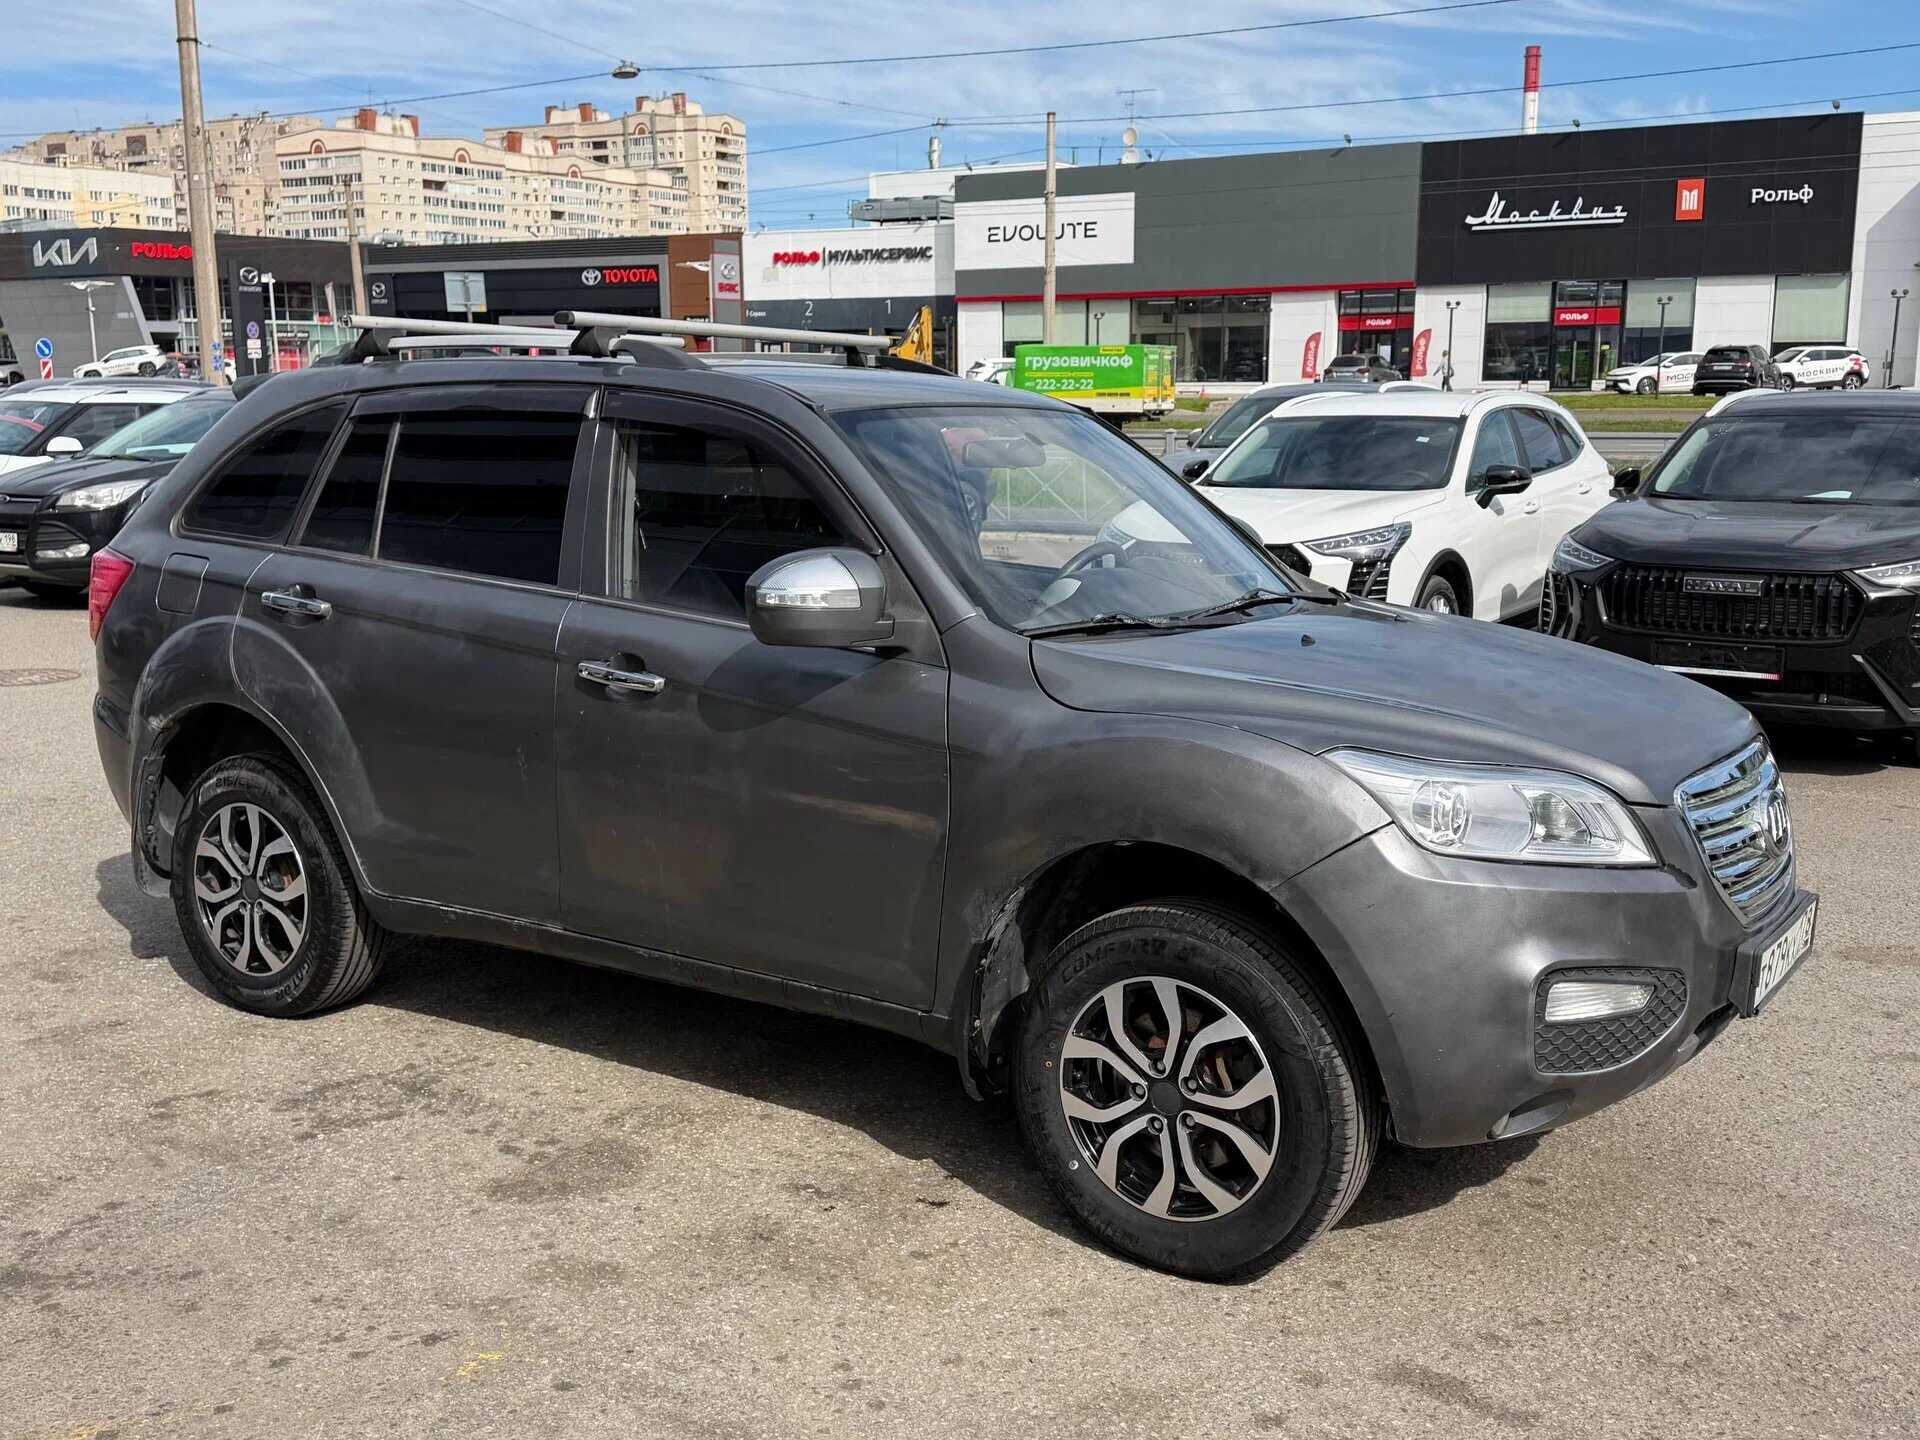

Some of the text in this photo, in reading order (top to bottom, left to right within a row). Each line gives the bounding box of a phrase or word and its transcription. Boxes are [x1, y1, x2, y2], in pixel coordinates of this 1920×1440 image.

[1751, 184, 1814, 204] Рольф
[1465, 191, 1627, 230] Москвич
[32, 237, 98, 267] KIA
[773, 246, 933, 266] РОЛЬФ МУЛЬТИСЕРВИС
[603, 268, 660, 284] TOYOTA
[805, 301, 813, 316] 2
[885, 299, 892, 315] 1
[1365, 319, 1392, 327] РОЛЬФ
[1559, 312, 1589, 321] РОЛЬФ
[1025, 354, 1133, 369] грузовичкоф
[1797, 366, 1844, 378] МОСКВИЧ
[1035, 379, 1093, 390] 222-22-22
